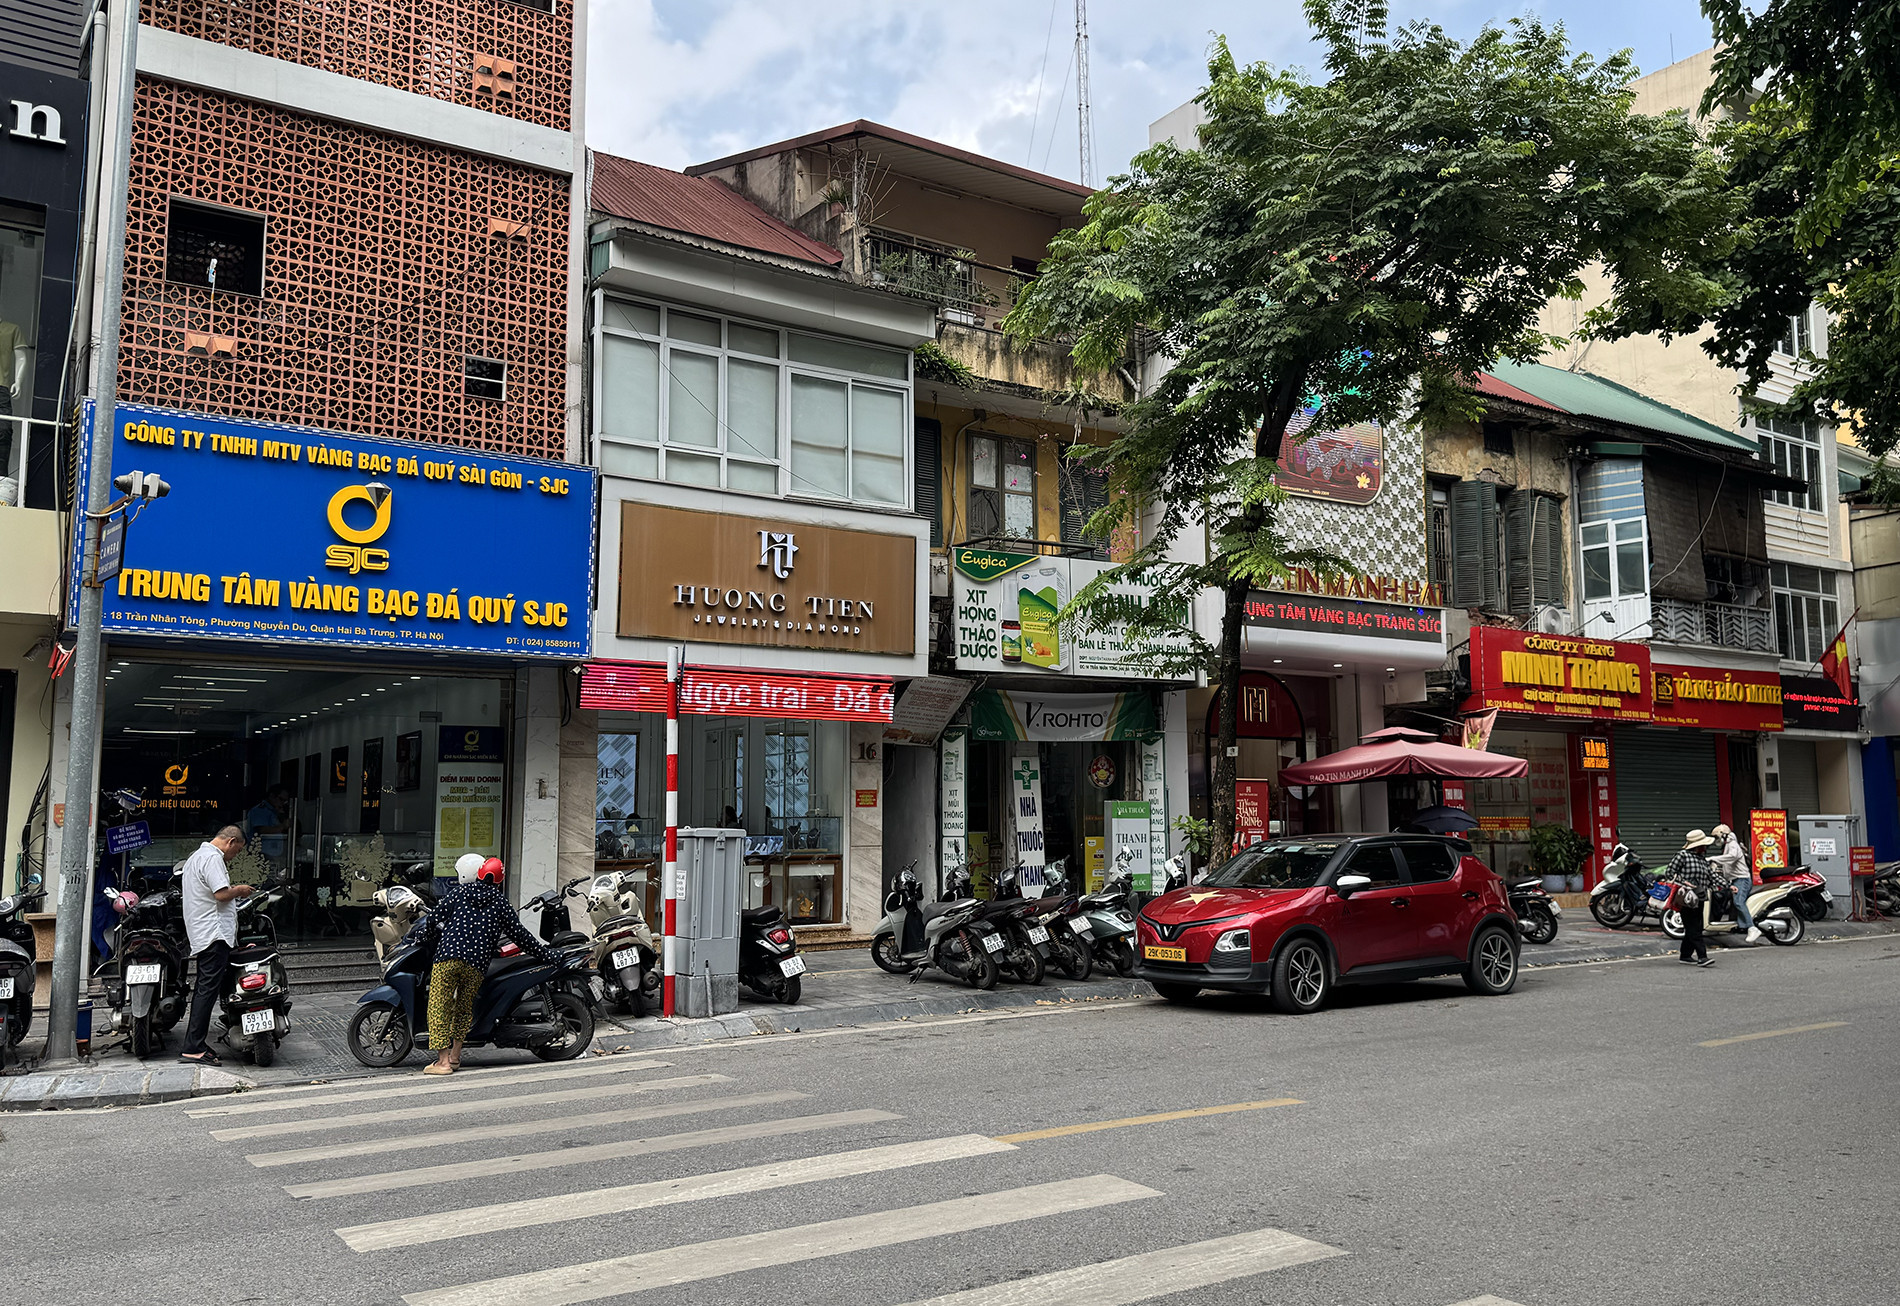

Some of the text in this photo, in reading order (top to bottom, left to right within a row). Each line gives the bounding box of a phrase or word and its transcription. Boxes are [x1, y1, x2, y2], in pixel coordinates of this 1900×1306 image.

[124, 420, 175, 446] CÔNG
[181, 430, 204, 449] TY
[210, 434, 257, 456] TNHH
[262, 440, 302, 462] MTV
[307, 443, 353, 467] VÀNG
[358, 452, 391, 475] BẠC
[396, 455, 419, 476] ĐÁ
[423, 461, 455, 480] QUÝ
[459, 463, 486, 484] SÀI
[490, 467, 522, 489] GÒN
[539, 477, 569, 495] SJC
[100, 541, 120, 560] CAMERA
[325, 544, 390, 574] SJC
[960, 550, 1005, 569] Eugica
[118, 568, 568, 628] TRUNG TÂM VÀNG BẠC ĐÁ QUÝ SJC
[674, 584, 874, 619] HUONG TIEN
[967, 589, 987, 605] XỊT
[959, 605, 996, 623] HỌNG
[1022, 607, 1052, 621] Eugica
[1278, 602, 1306, 621] TÂM
[1308, 606, 1344, 625] VÀNG
[1347, 613, 1372, 630] BẠC
[1418, 615, 1442, 633] SỨC
[111, 611, 444, 641] 18 Trần Nhân Tông, Phường Nguyễn Du, Quận Hai Bà Trưng, TP. Hà Nội
[694, 614, 768, 628] JEWELRY
[786, 621, 861, 635] DIAMOND
[960, 623, 996, 642] THẢO
[506, 637, 520, 645] ĐT:
[545, 639, 581, 648] 85859111
[960, 643, 997, 660] DƯỢC
[1079, 638, 1095, 650] BÁN
[1523, 634, 1615, 657] CÔNG TY VÀNG
[1501, 650, 1641, 694] MINH TRANG
[761, 681, 809, 710] trai
[1523, 688, 1537, 702] GIỮ
[1673, 672, 1714, 700] VÀNG
[1714, 672, 1744, 702] BẢO
[1744, 683, 1783, 705] MINH
[858, 742, 877, 760] 16
[1584, 739, 1607, 757] VÀNG
[440, 774, 458, 783] ĐIỂM
[163, 786, 187, 796] SJC
[948, 789, 958, 799] XỊT
[1020, 792, 1037, 817] NHÀ
[943, 809, 964, 819] THÔNG
[943, 822, 964, 830] XOANG
[1018, 823, 1043, 852] THUỐC
[1116, 833, 1147, 844] THANH
[1020, 864, 1046, 887] THANH
[1147, 948, 1183, 959] 29K-053.06
[246, 1011, 268, 1023] 59-Y1
[245, 1021, 273, 1034] 422.99
